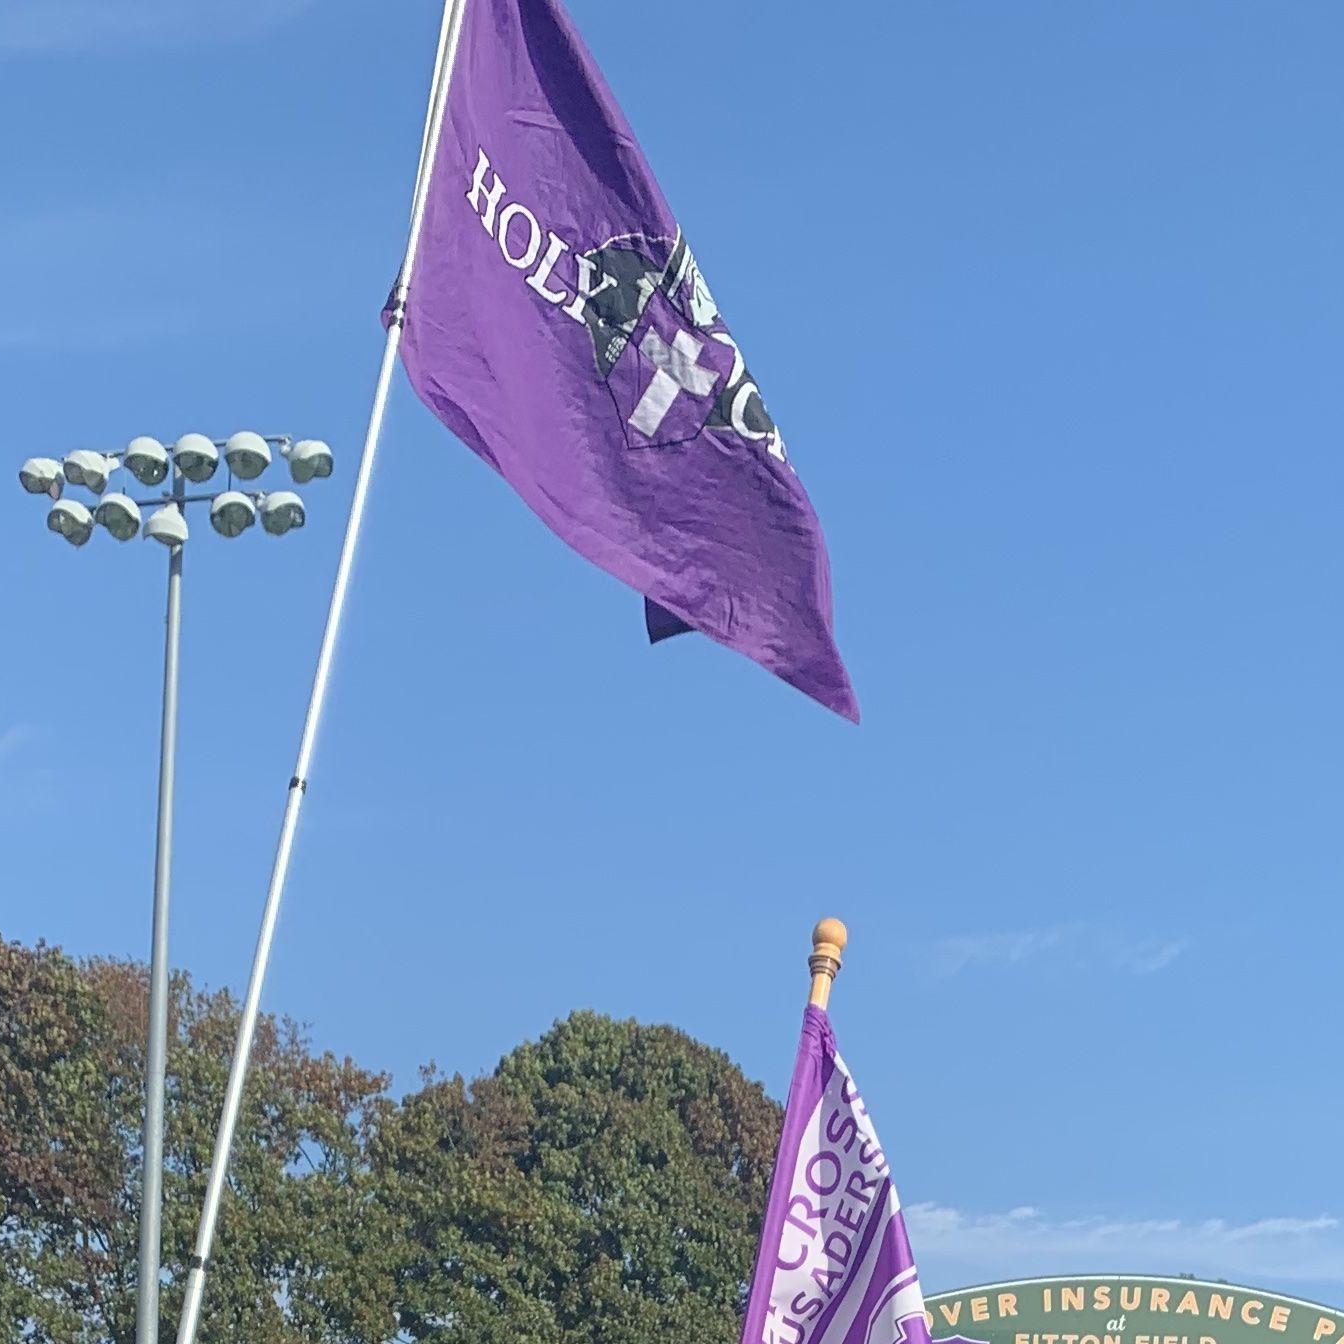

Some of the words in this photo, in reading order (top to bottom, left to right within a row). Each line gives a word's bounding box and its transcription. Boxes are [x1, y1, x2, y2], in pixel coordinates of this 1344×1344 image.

[466, 148, 617, 324] HOLY
[1043, 1286, 1291, 1331] INSURANCE
[1106, 1314, 1127, 1332] at
